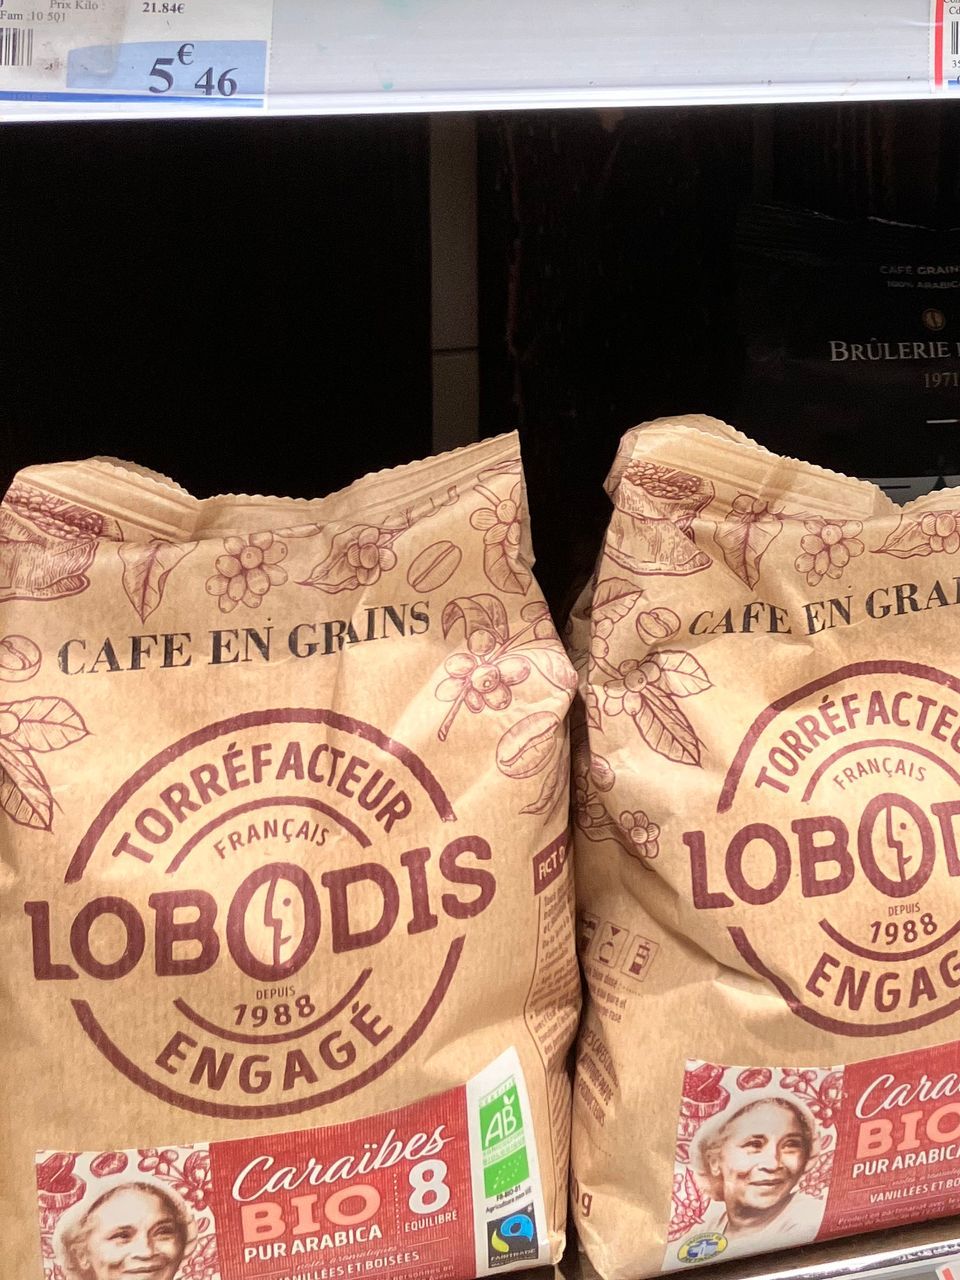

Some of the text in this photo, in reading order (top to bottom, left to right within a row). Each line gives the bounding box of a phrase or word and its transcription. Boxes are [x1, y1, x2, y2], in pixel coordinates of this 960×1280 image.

[50, 0, 186, 14] Prix Kilo 21.84€
[829, 336, 951, 362] BRÛLERIE
[923, 372, 960, 388] 1971
[688, 602, 793, 636] CAFE
[801, 594, 853, 636] EN
[57, 600, 432, 676] CAFE EN GRAINS
[833, 757, 928, 791] FRANÇAIS
[112, 740, 414, 865] TORRÉFACTEUR
[214, 818, 330, 860] FRANÇAIS
[24, 834, 497, 982] LOBODIS
[888, 902, 921, 917] DEPUIS
[869, 912, 938, 946] 1988
[234, 993, 316, 1027] 1988
[256, 985, 296, 1001] DEPUIS
[155, 999, 394, 1095] ENGAGÉ
[485, 1105, 517, 1148] AB
[232, 1124, 455, 1202] Caraïbes
[852, 1158, 890, 1179] PUR
[407, 1158, 451, 1215] 8
[240, 1183, 381, 1244] BIO
[244, 1223, 383, 1264] PUR ARABICA
[365, 1250, 420, 1270] BOISÉES
[490, 1248, 537, 1263] FAIRTRADE
